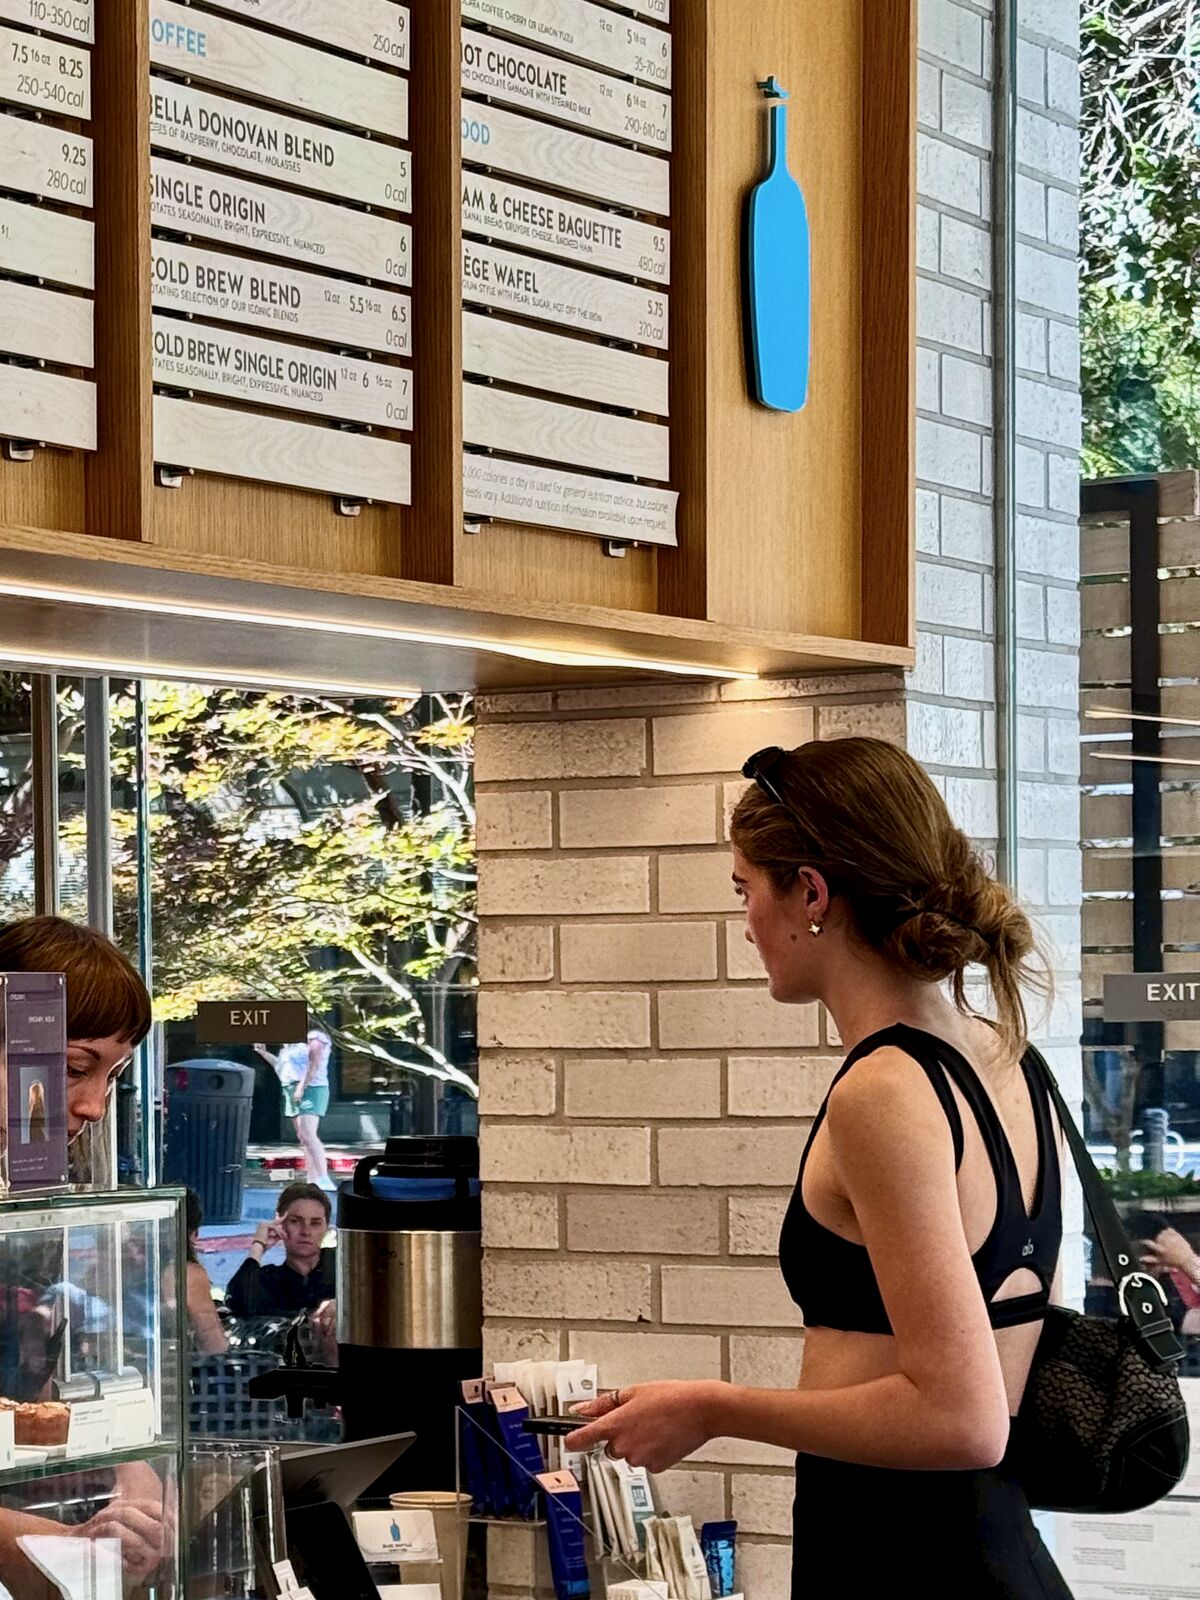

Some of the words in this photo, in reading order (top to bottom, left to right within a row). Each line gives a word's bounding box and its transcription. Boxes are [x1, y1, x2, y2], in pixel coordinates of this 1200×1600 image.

[29, 0, 71, 28] 110-350
[73, 16, 90, 34] cal
[398, 15, 405, 33] 9
[151, 19, 207, 58] OFFEE
[373, 34, 390, 53] 250
[390, 43, 405, 60] cal
[626, 29, 632, 44] 5
[661, 43, 667, 58] 6
[12, 43, 28, 63] 7.5
[31, 49, 40, 62] 16
[41, 55, 51, 66] oz
[59, 56, 83, 79] 8.25
[634, 56, 656, 77] 35-70
[656, 65, 668, 80] cal
[17, 74, 66, 103] 250-540
[67, 90, 84, 108] cal
[461, 42, 482, 68] OT
[487, 50, 567, 96] CHOCOLATE
[626, 93, 632, 108] 6
[662, 104, 667, 119] 7
[150, 94, 193, 128] ELLA
[199, 109, 278, 152] DONOVAN
[284, 132, 335, 168] BLEND
[399, 161, 406, 178] 5
[462, 117, 490, 145] OOD
[656, 126, 668, 142] cal
[62, 143, 86, 166] 9.25
[47, 169, 69, 191] 280
[69, 173, 87, 195] cal
[384, 182, 392, 198] 0
[392, 187, 407, 204] cal
[151, 201, 175, 216] OTATES
[209, 189, 266, 224] ORIGIN
[399, 236, 407, 252] 6
[462, 186, 485, 211] AM
[489, 192, 498, 214] &
[503, 196, 554, 230] CHEESE
[558, 212, 622, 249] BAGUETTE
[653, 235, 665, 253] 9.5
[385, 258, 392, 274] 0
[392, 262, 407, 278] cal
[196, 265, 244, 298] BREW
[250, 277, 301, 309] BLEND
[324, 290, 332, 303] 12
[332, 294, 341, 305] oz
[349, 295, 364, 314] 5.5
[391, 305, 407, 323] 6.5
[463, 247, 489, 282] ÈGE
[494, 262, 539, 294] WAFEL
[647, 300, 663, 317] 5.75
[220, 297, 230, 308] OF
[231, 301, 246, 312] OUR
[385, 330, 393, 346] 0
[393, 333, 407, 349] cal
[154, 330, 184, 358] OLD
[188, 337, 232, 368] BREW
[234, 350, 284, 380] SINGLE
[288, 361, 337, 391] ORIGIN
[362, 372, 369, 388] 6
[400, 379, 408, 396] 7
[385, 403, 393, 419] 0
[393, 406, 408, 421] cal
[1147, 983, 1200, 1001] EXIT
[230, 1010, 270, 1025] EXIT
